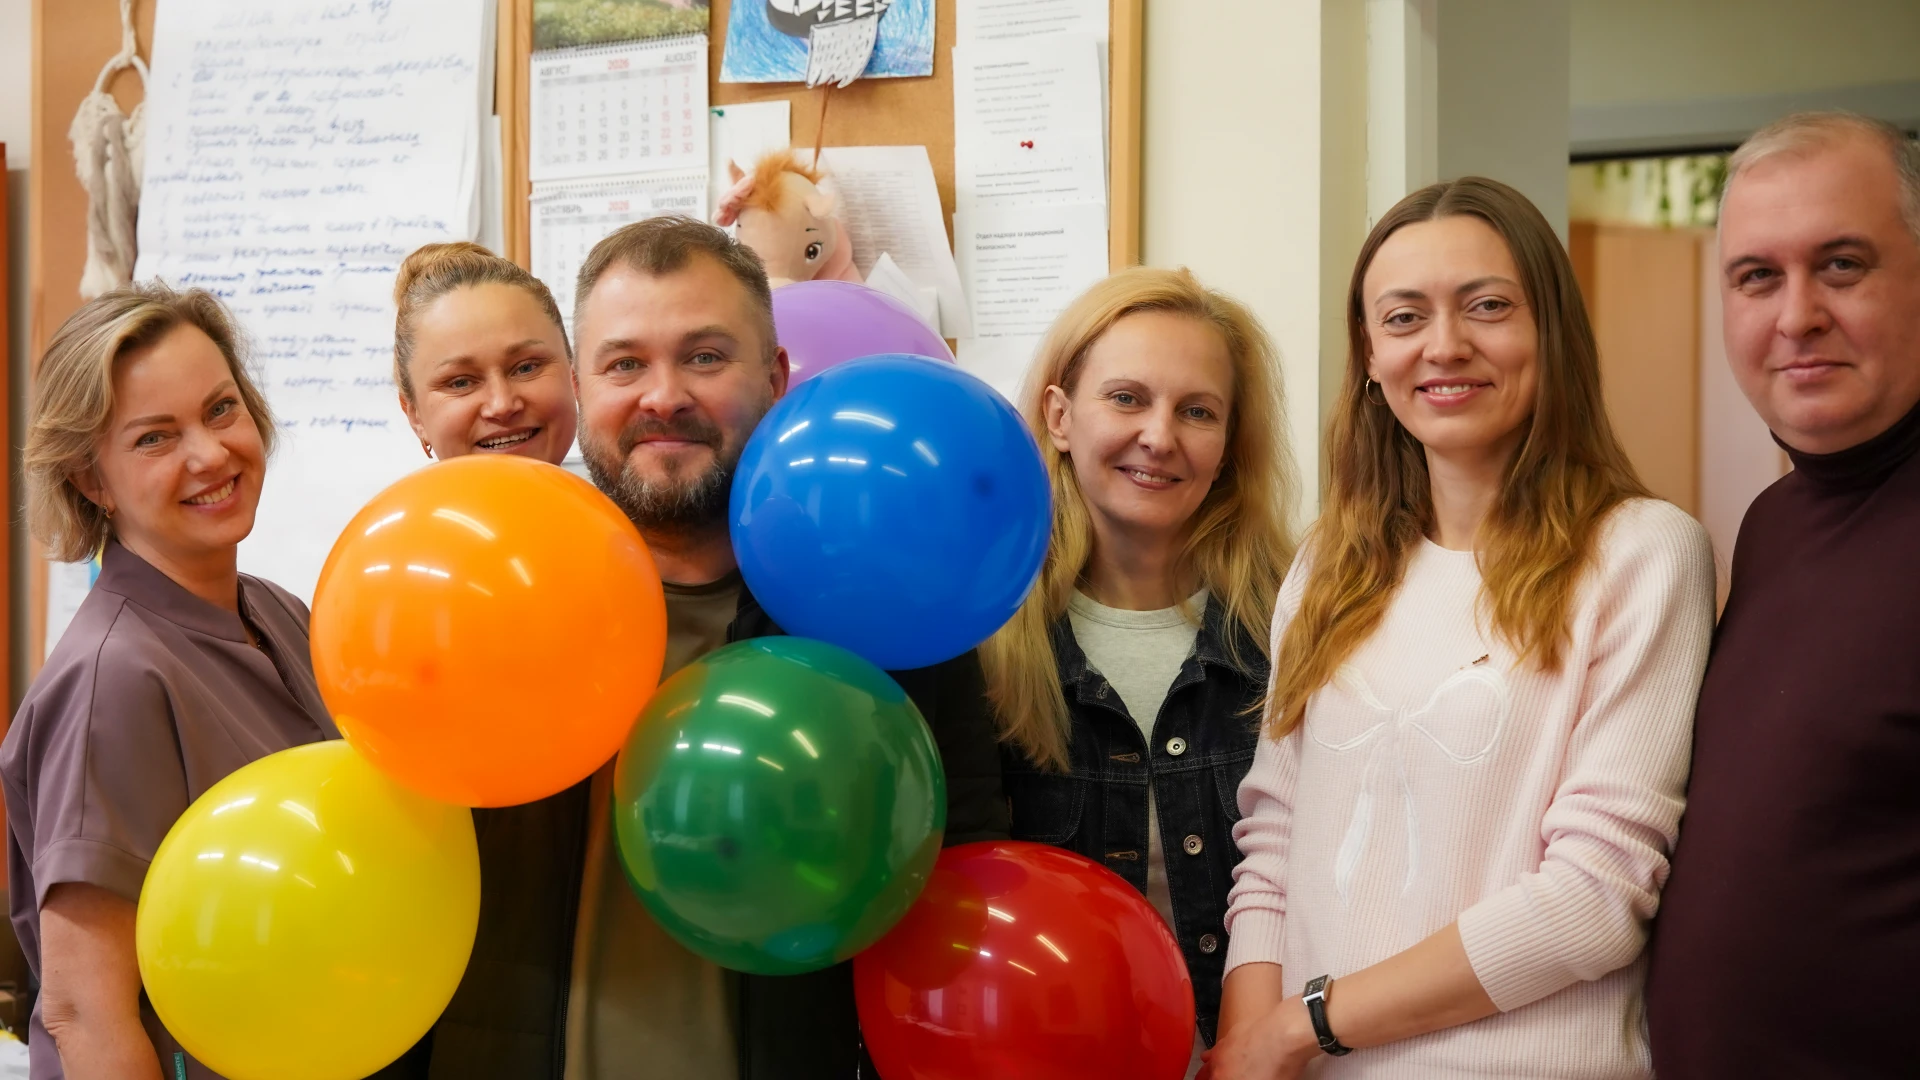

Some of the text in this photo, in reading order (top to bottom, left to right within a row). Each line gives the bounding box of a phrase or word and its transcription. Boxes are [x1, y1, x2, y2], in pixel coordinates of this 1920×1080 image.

[664, 52, 698, 63] AUGUST
[539, 65, 571, 76] АВГУСТ
[651, 196, 698, 208] SEPTEMBER
[539, 205, 583, 215] СЕНТЯБРЬ
[975, 232, 993, 240] Отдел
